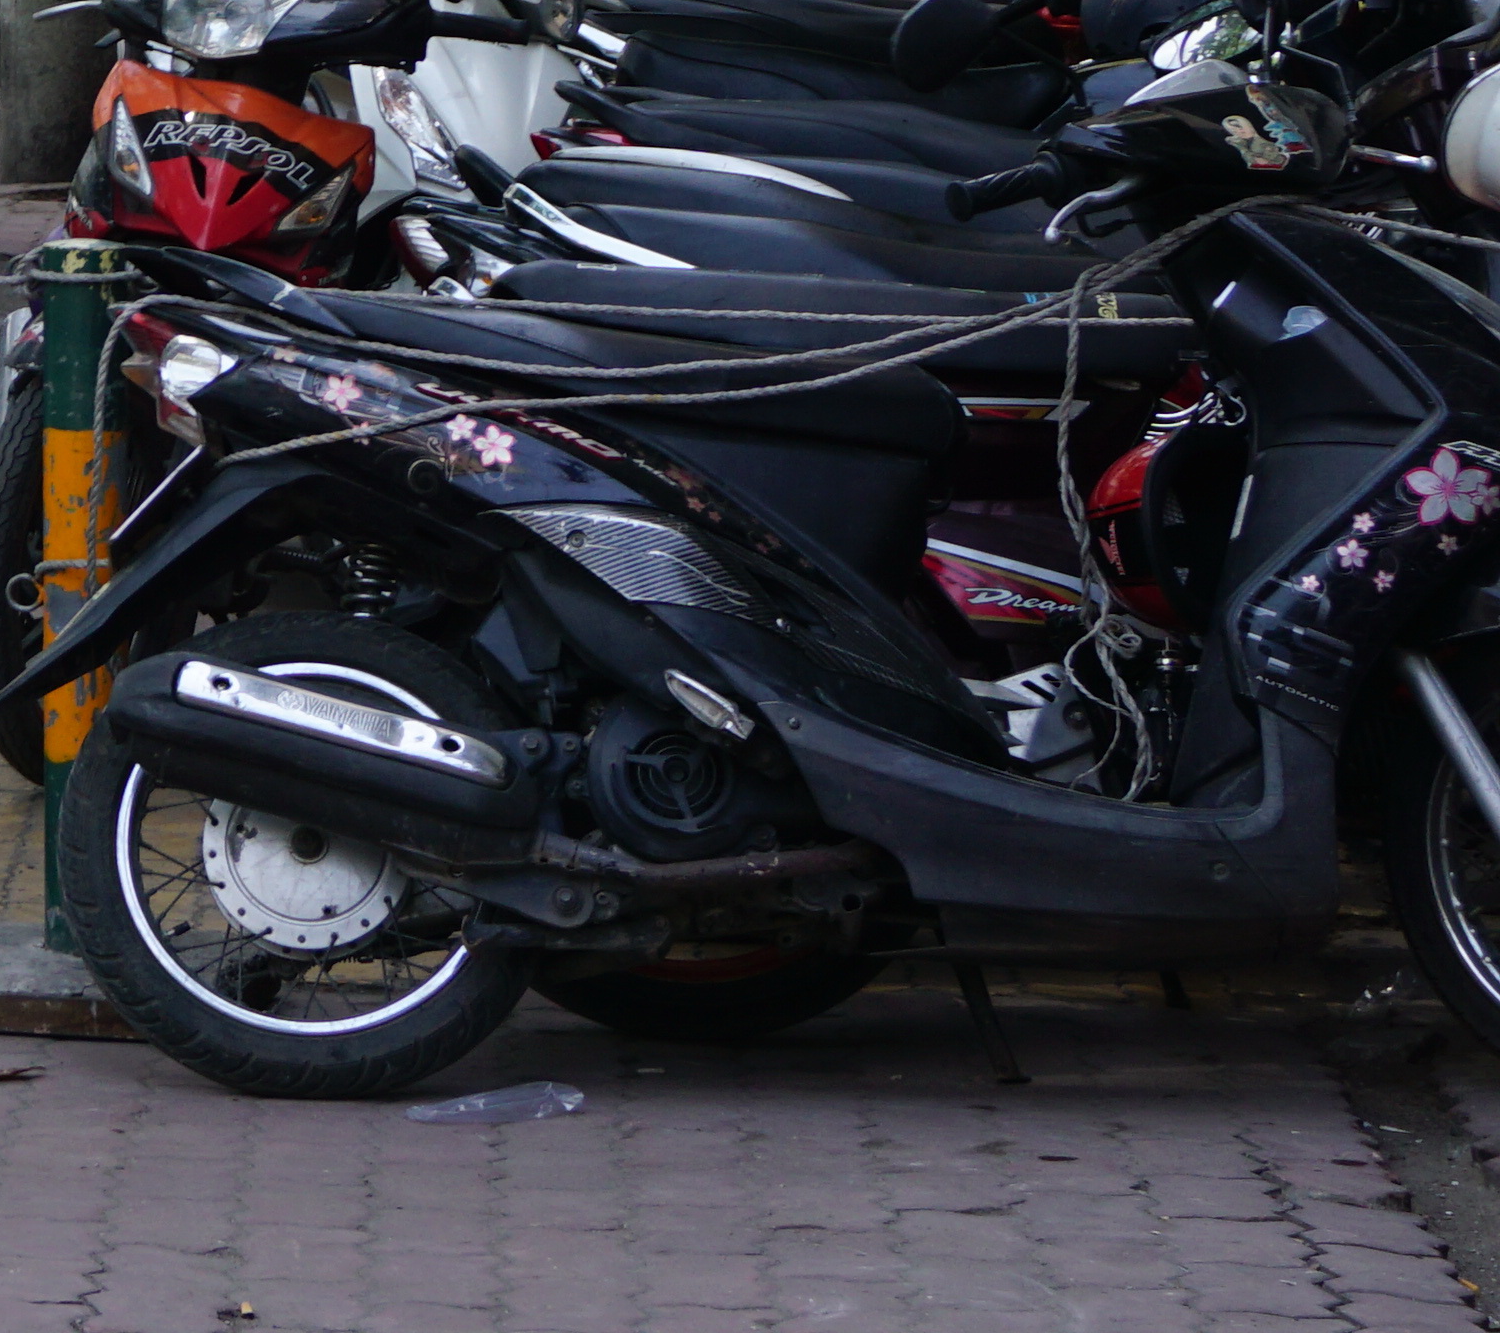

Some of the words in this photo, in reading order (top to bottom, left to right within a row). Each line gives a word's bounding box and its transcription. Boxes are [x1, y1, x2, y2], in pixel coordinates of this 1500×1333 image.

[964, 586, 1084, 613] Dream
[1254, 673, 1340, 713] AUTOMATIC
[306, 696, 392, 737] YAMAHA
